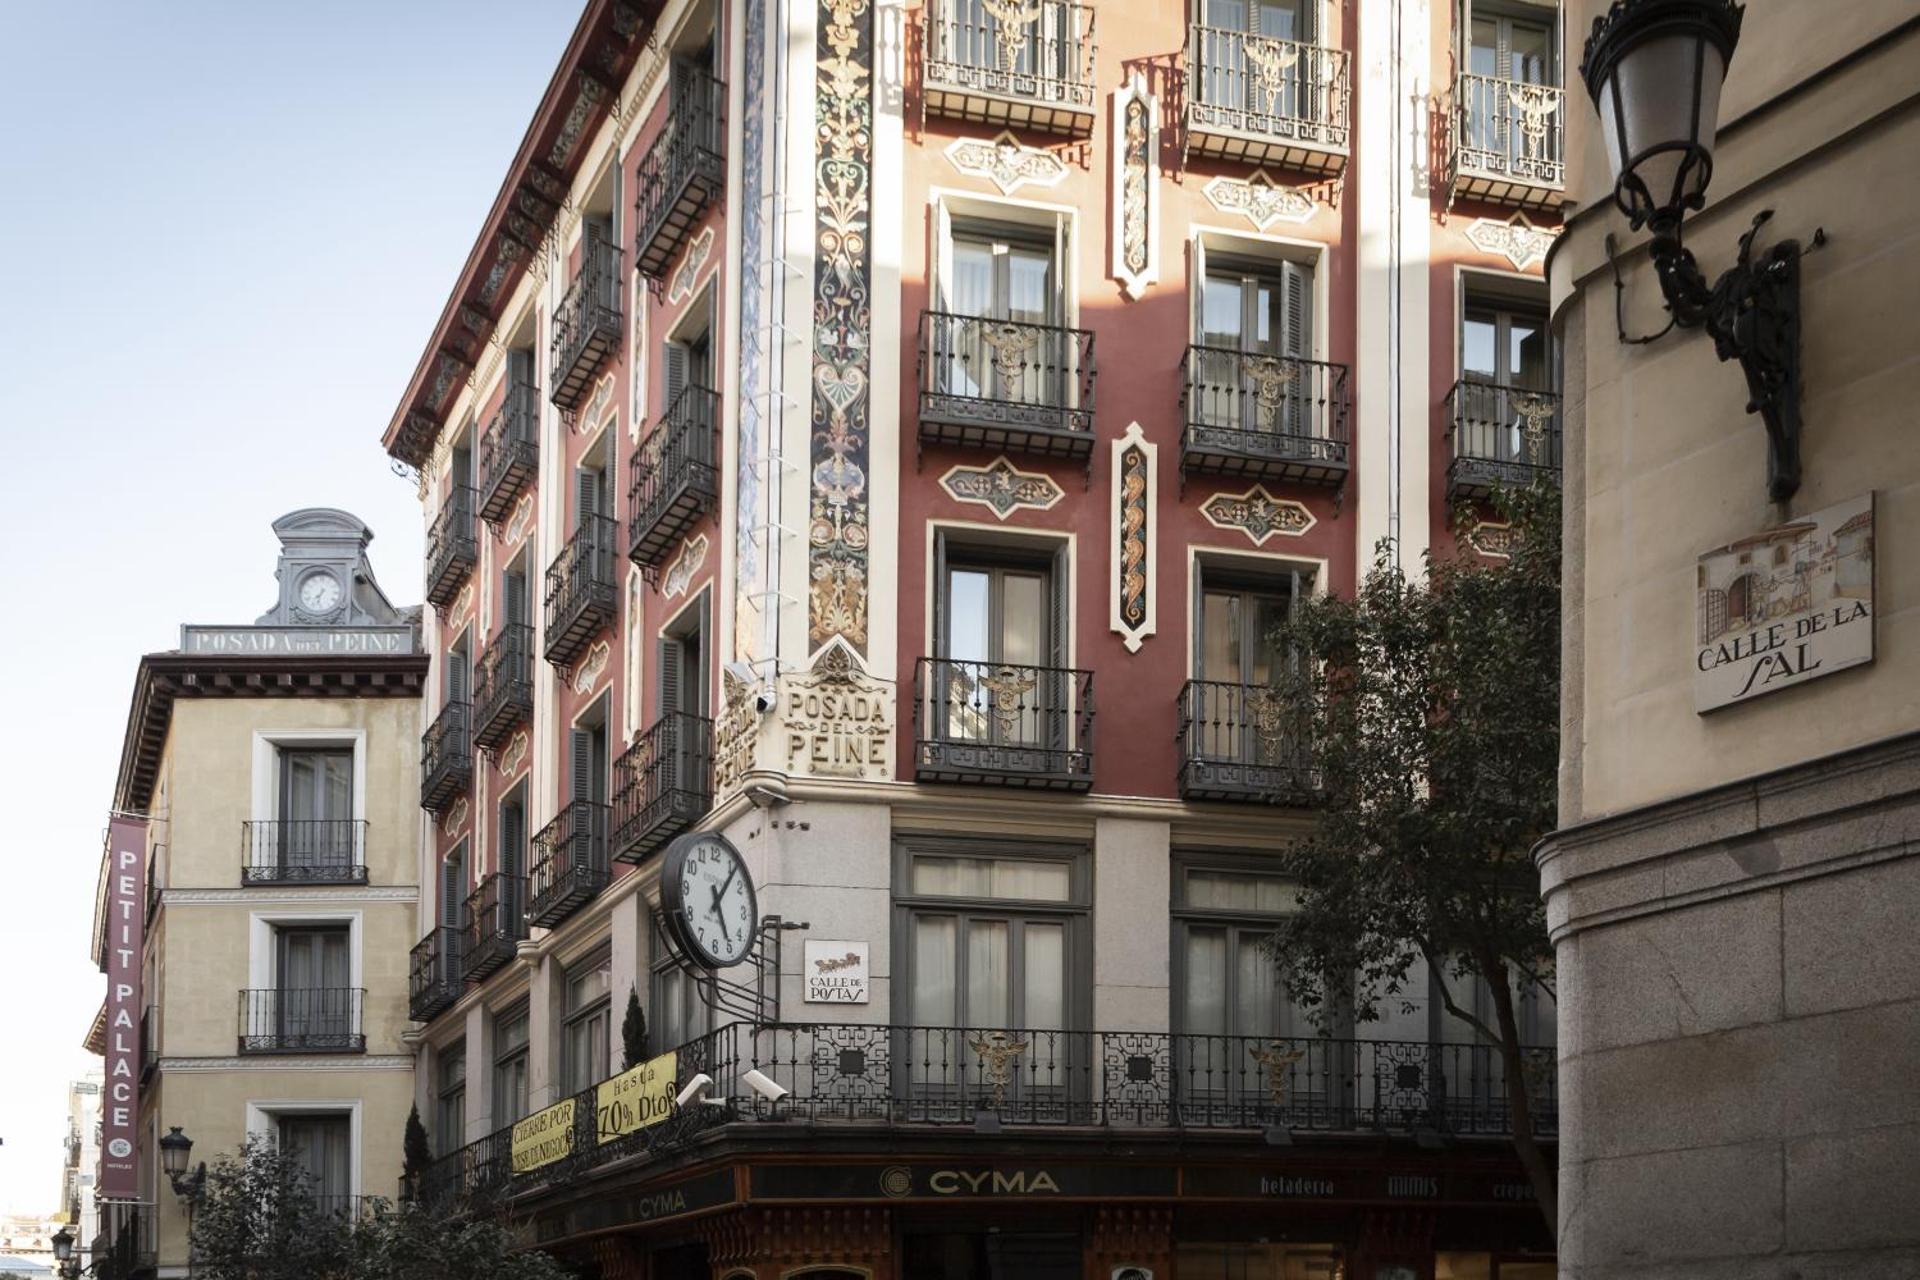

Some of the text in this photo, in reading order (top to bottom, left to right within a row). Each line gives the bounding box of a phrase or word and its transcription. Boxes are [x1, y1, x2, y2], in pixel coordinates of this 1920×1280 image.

[195, 633, 401, 652] POSADA DEL PEINE
[1697, 600, 1869, 672] CALLE DE LA
[1732, 643, 1824, 698] SAL
[788, 692, 885, 723] POSADA
[819, 721, 853, 735] DEL
[788, 735, 886, 764] PEINE
[697, 847, 706, 864] 11
[710, 846, 721, 863] 12
[687, 859, 697, 876] 10
[727, 860, 734, 874] 1
[682, 880, 690, 896] 9
[736, 880, 743, 895] 2
[686, 905, 693, 922] 8
[740, 905, 747, 921] 3
[697, 927, 705, 942] 7
[735, 927, 742, 941] 4
[711, 938, 719, 954] 6
[726, 938, 733, 954] 5
[112, 850, 137, 1128] PETIT PALACE
[810, 977, 862, 987] CALLE DE
[811, 987, 864, 1001] POSTAS
[613, 1067, 655, 1097] Hasta
[513, 1103, 572, 1145] CIERRE POR
[929, 1170, 1060, 1194] CYMA
[639, 1190, 687, 1219] CYMA
